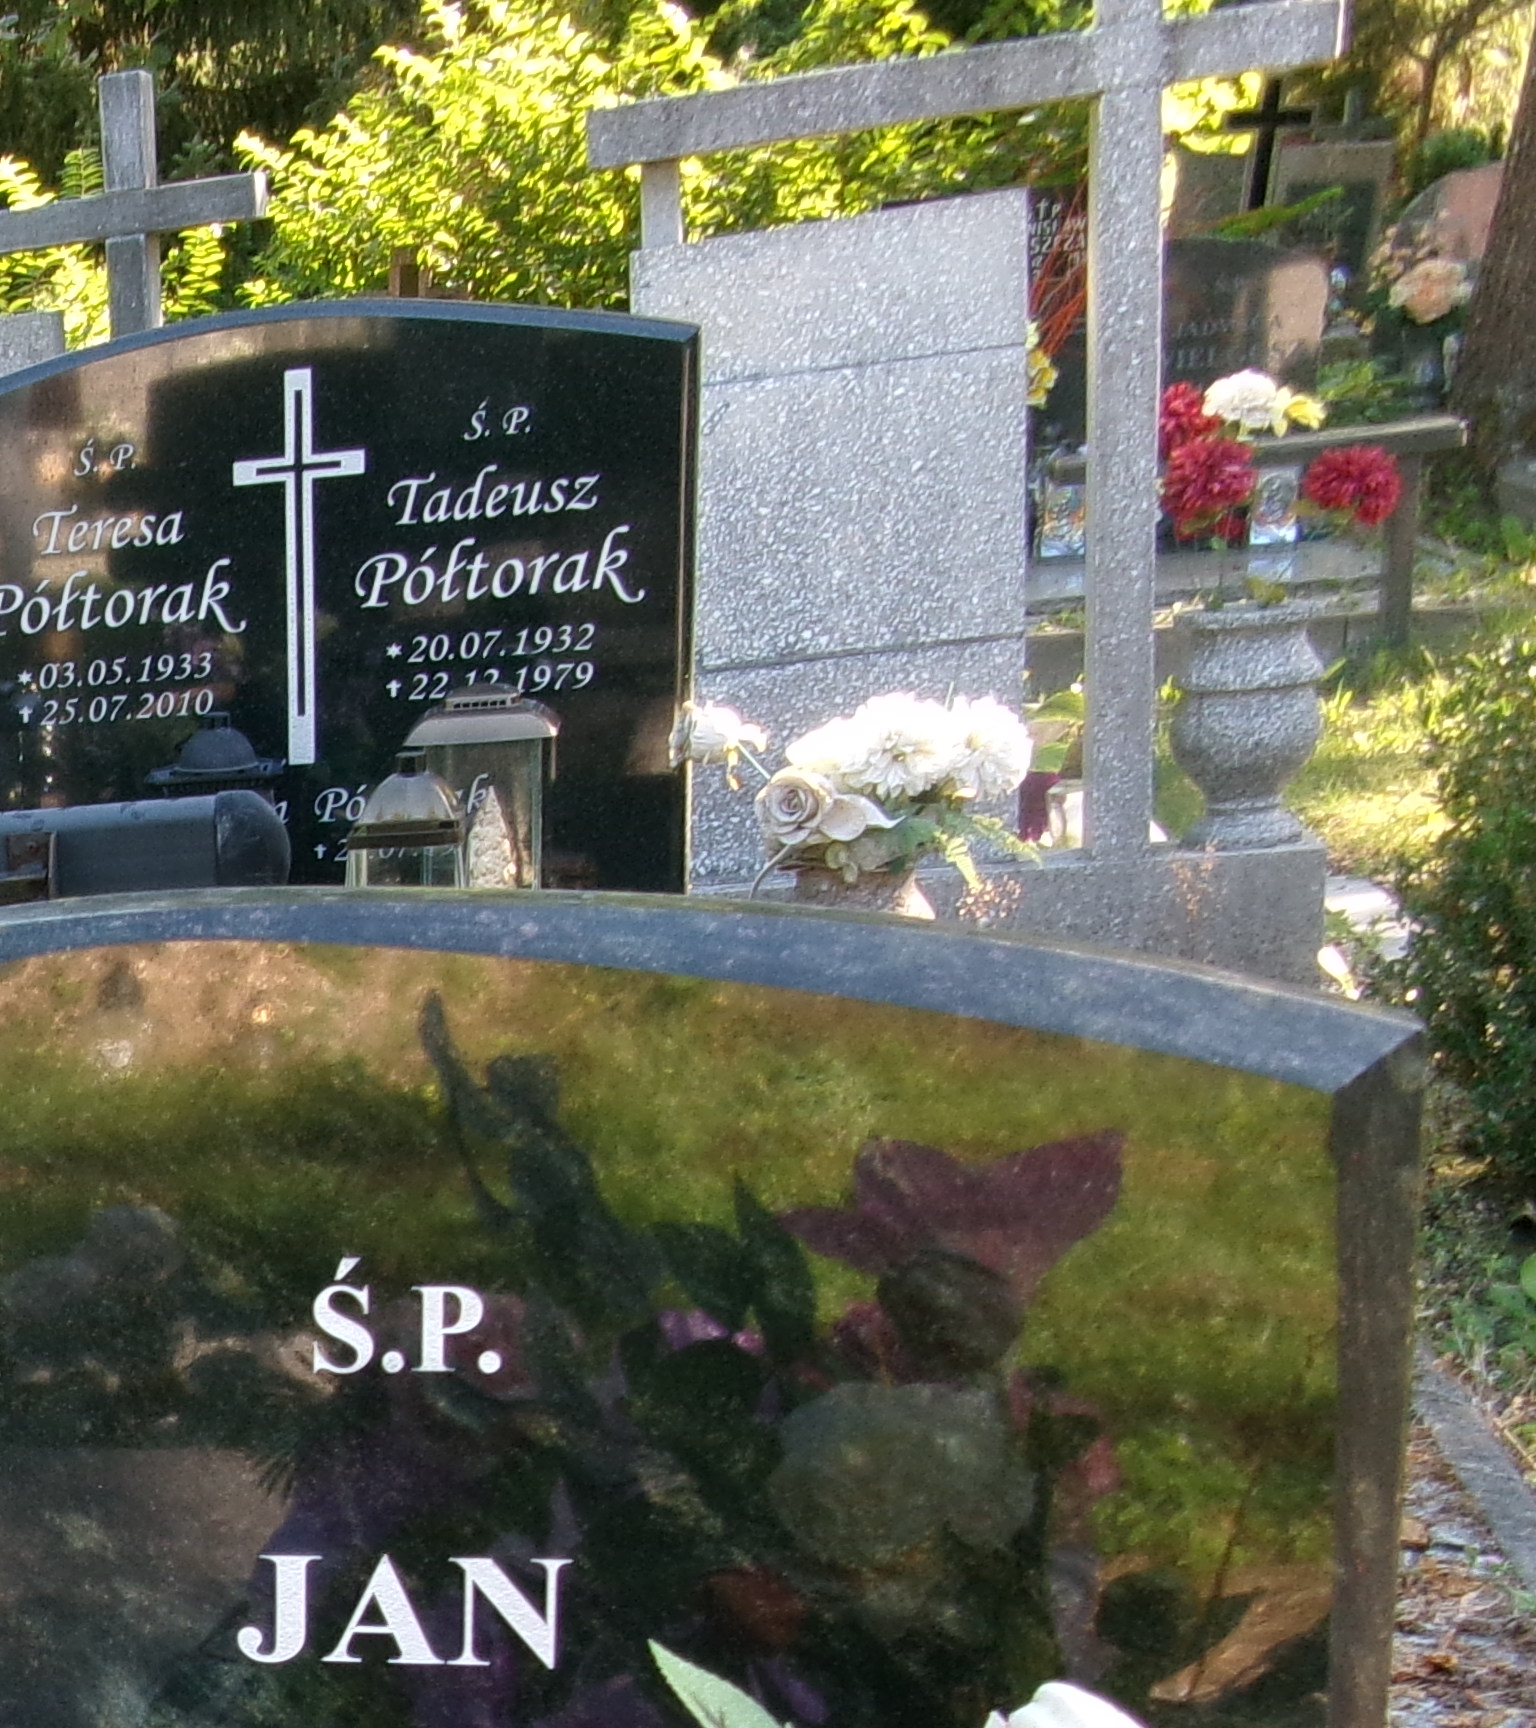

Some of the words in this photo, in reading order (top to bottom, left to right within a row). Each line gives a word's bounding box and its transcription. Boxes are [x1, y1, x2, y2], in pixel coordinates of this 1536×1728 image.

[502, 406, 531, 436] P.
[109, 443, 136, 471] P.
[386, 464, 601, 526] Tadeusz
[32, 503, 185, 555] Teresa
[354, 524, 646, 609] Półtorak
[407, 622, 596, 664] 20.07.1932
[39, 652, 213, 690] 03.05.1933
[407, 661, 595, 701] 22121979
[40, 688, 215, 727] 25.07.2010
[311, 1257, 503, 1375] Ś.P.
[237, 1553, 574, 1671] JAN
